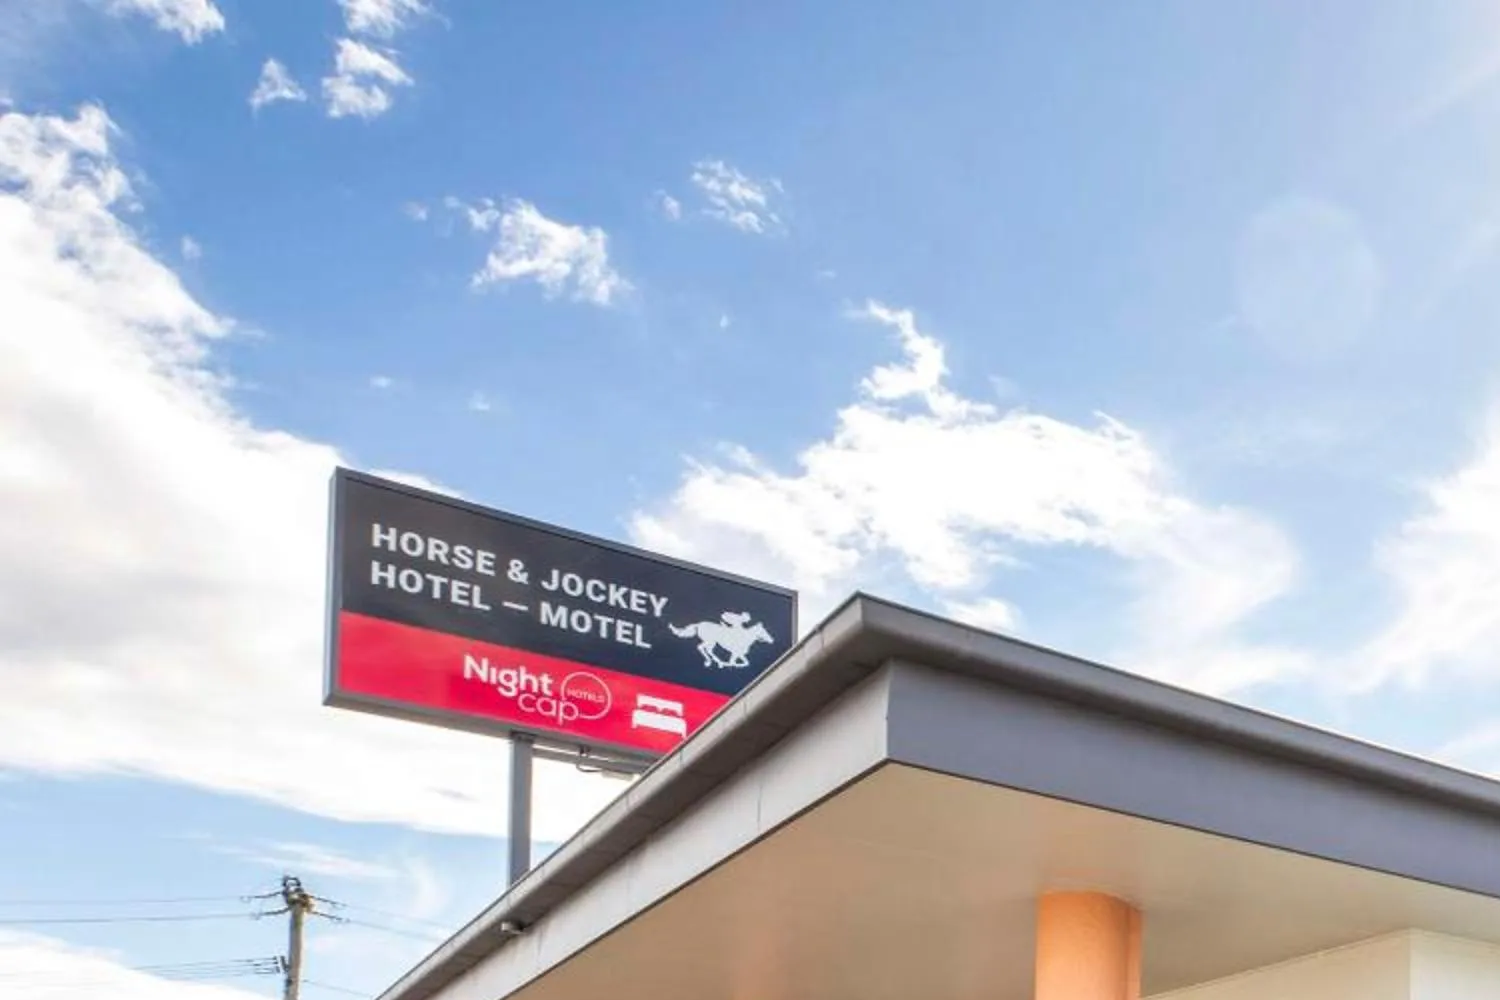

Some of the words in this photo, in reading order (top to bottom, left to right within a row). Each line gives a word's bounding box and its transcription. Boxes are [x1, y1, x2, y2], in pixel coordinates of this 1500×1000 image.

[372, 523, 496, 576] HORSE
[507, 559, 529, 585] &
[541, 568, 668, 617] JOCKEY
[371, 560, 492, 611] HOTEL
[540, 601, 652, 649] MOTEL
[464, 654, 554, 697] Night
[566, 688, 605, 703] HOTELS
[518, 693, 579, 725] cap
